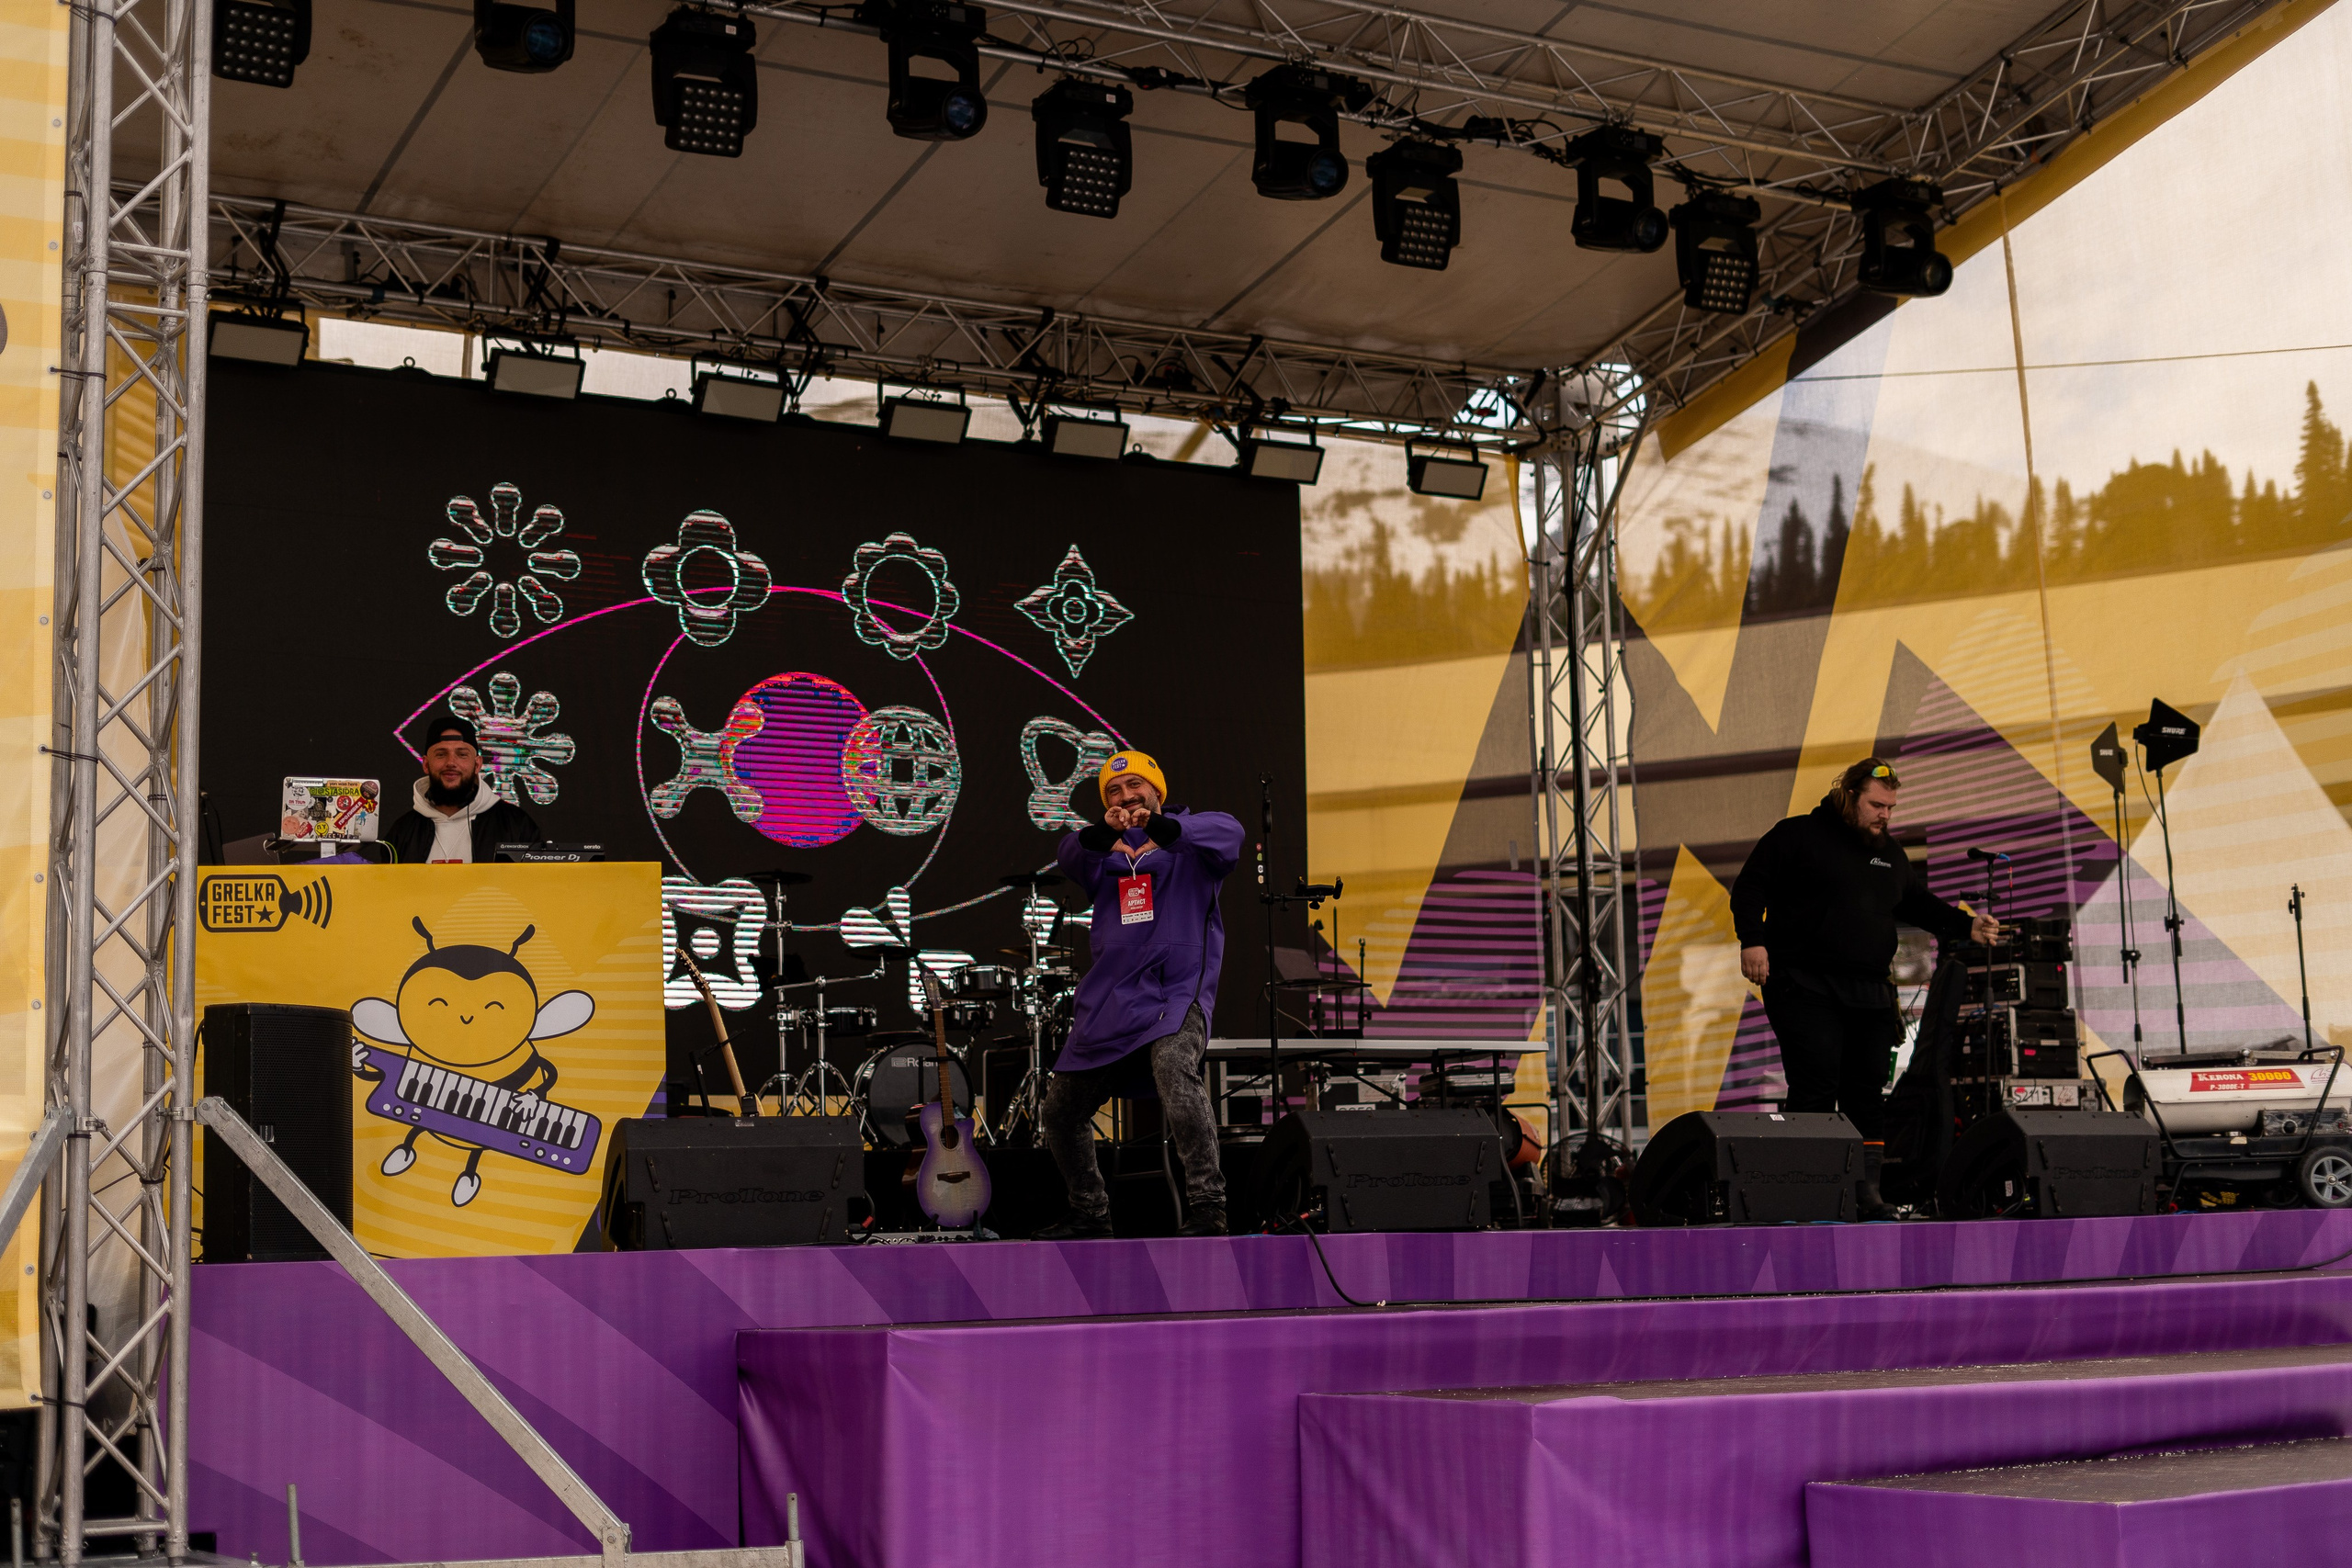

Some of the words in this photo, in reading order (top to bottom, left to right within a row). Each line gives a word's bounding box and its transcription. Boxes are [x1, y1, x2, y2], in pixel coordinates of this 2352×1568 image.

[2161, 727, 2186, 735] SHURE
[522, 852, 566, 861] Pioneer
[212, 883, 275, 902] GRELKA
[1127, 898, 1146, 907] АРТИСТ
[212, 905, 255, 924] FEST
[2247, 1071, 2292, 1081] 30000
[1346, 1172, 1471, 1189] ProTone
[1744, 1170, 1842, 1184] ProTone
[667, 1187, 825, 1204] ProTone
